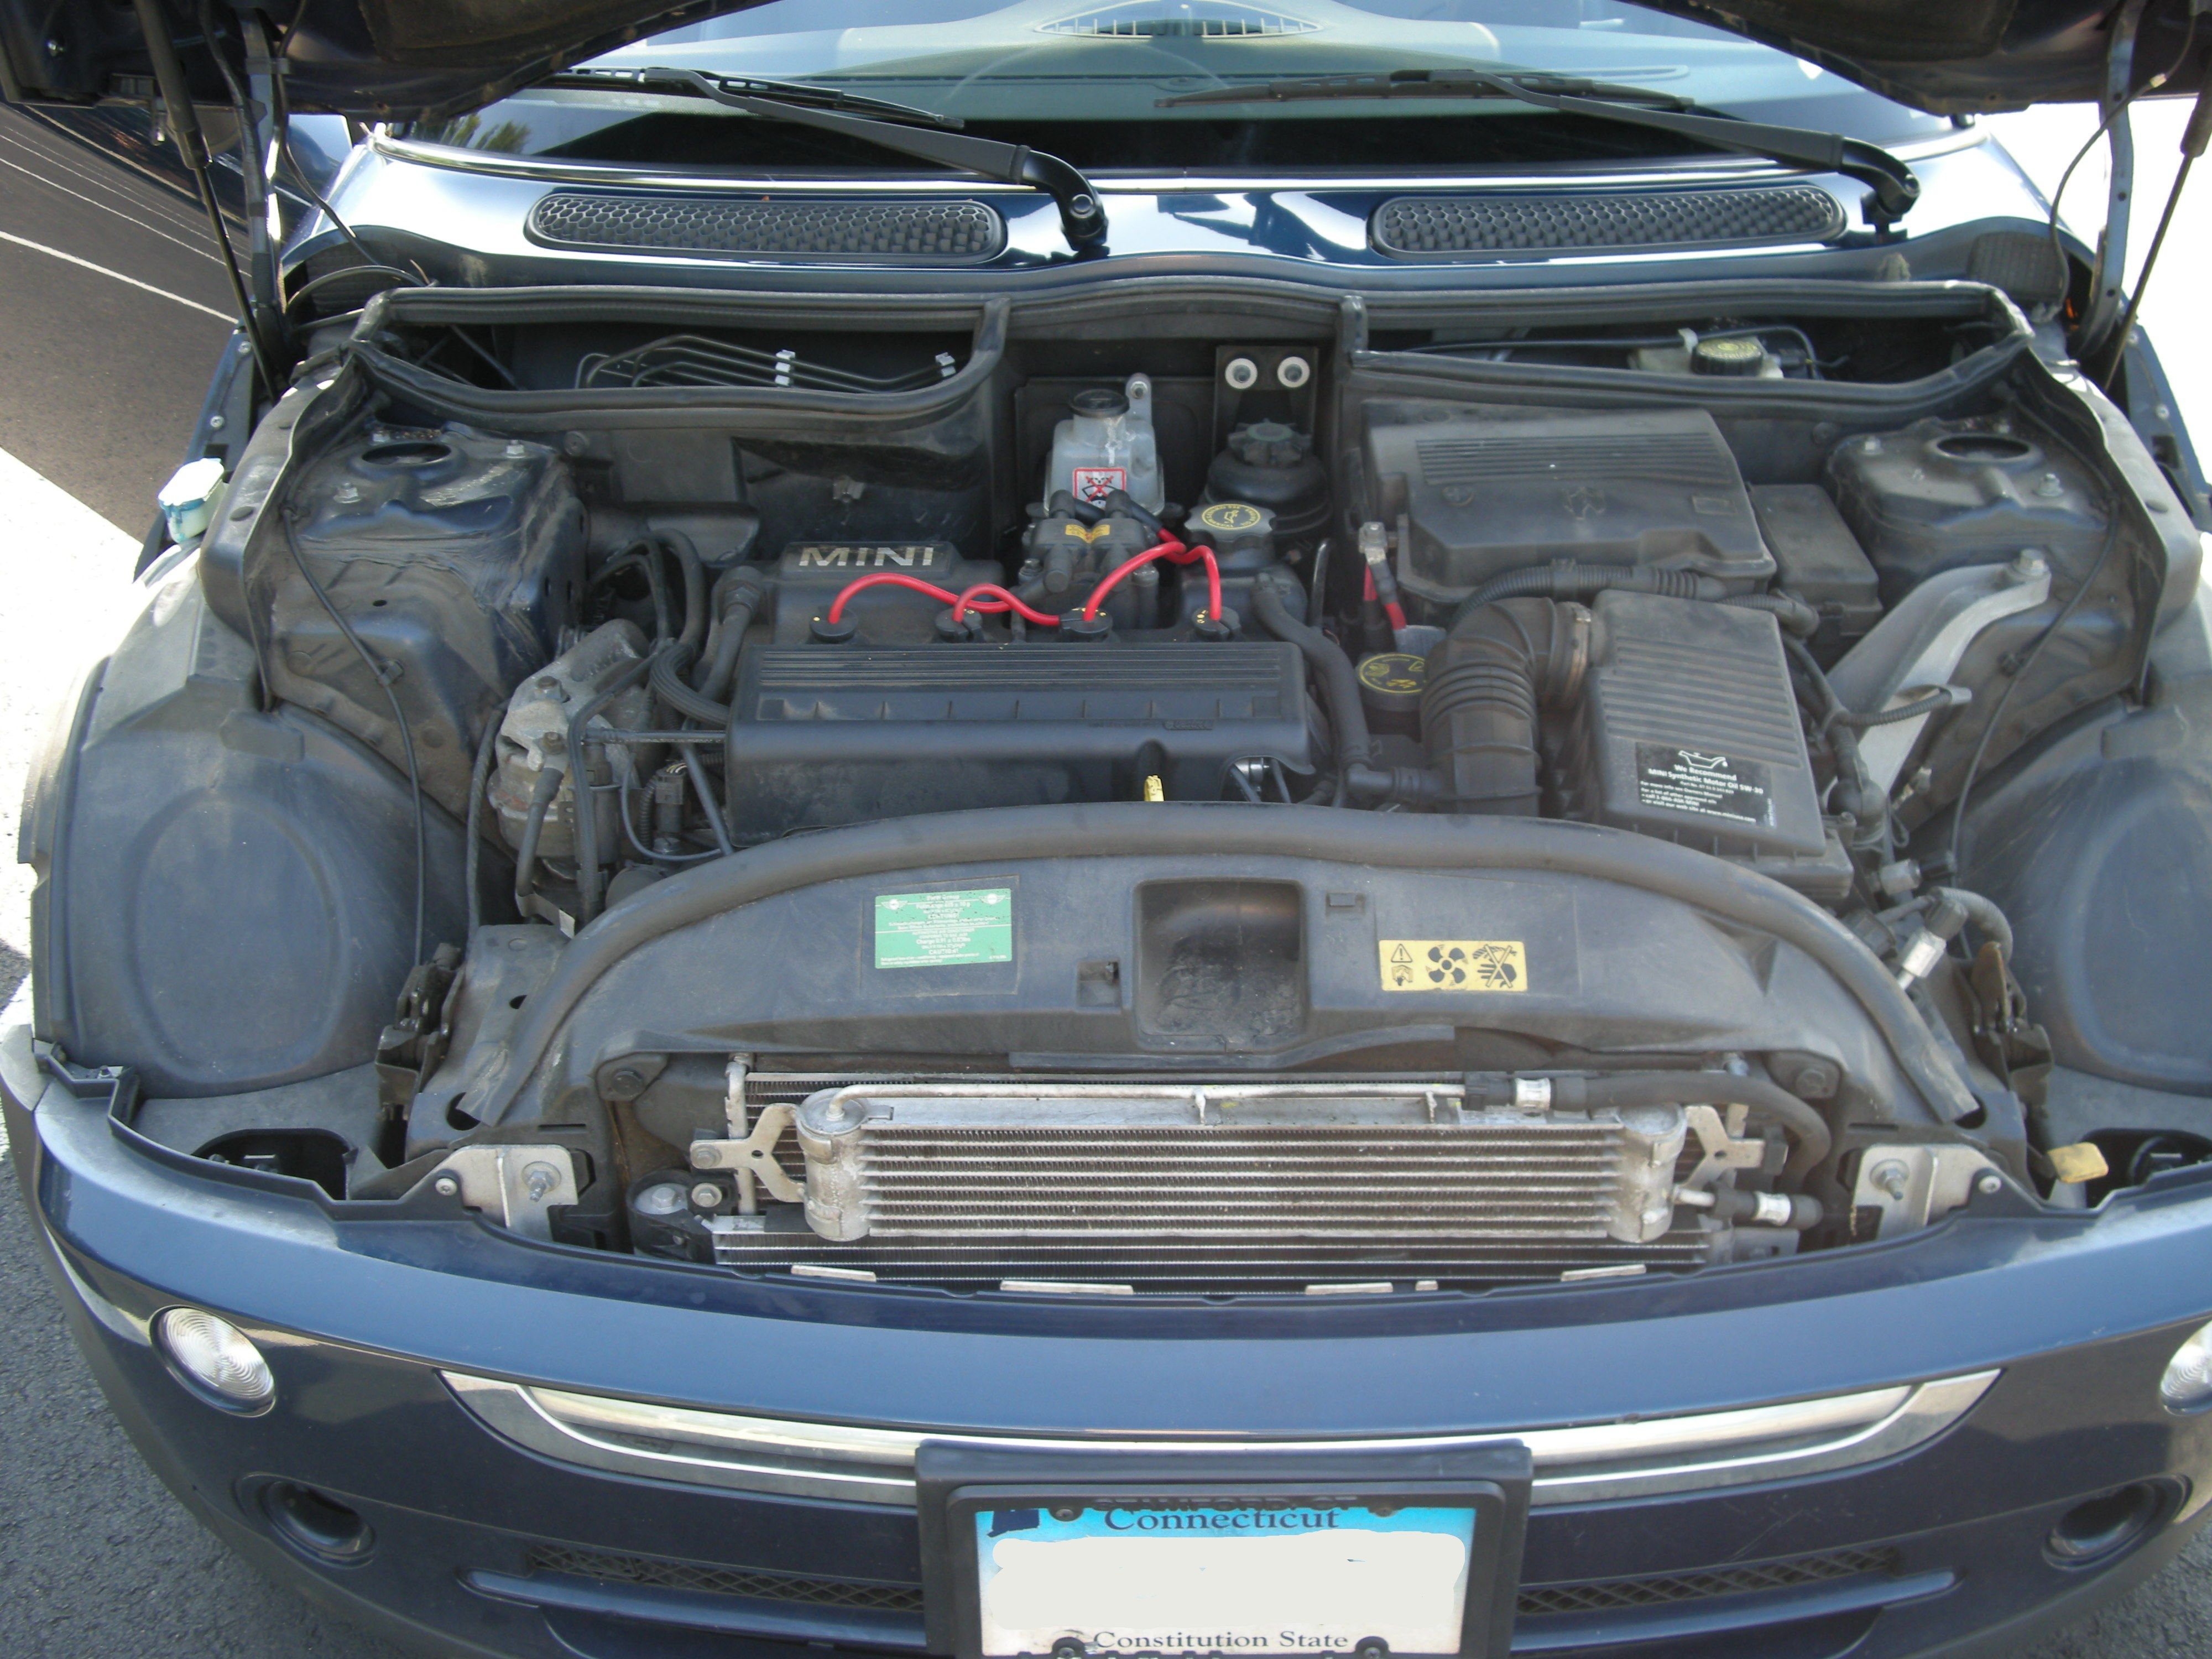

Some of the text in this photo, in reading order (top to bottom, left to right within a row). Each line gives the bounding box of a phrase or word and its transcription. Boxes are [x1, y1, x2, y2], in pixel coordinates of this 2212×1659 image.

[799, 546, 935, 567] MINI
[1647, 768, 1764, 794] MINI Synthetic Motor Oil 5W-30
[1673, 764, 1736, 781] We Recommend
[1104, 1507, 1340, 1530] Connecticut
[1093, 1631, 1349, 1648] Constitution State
